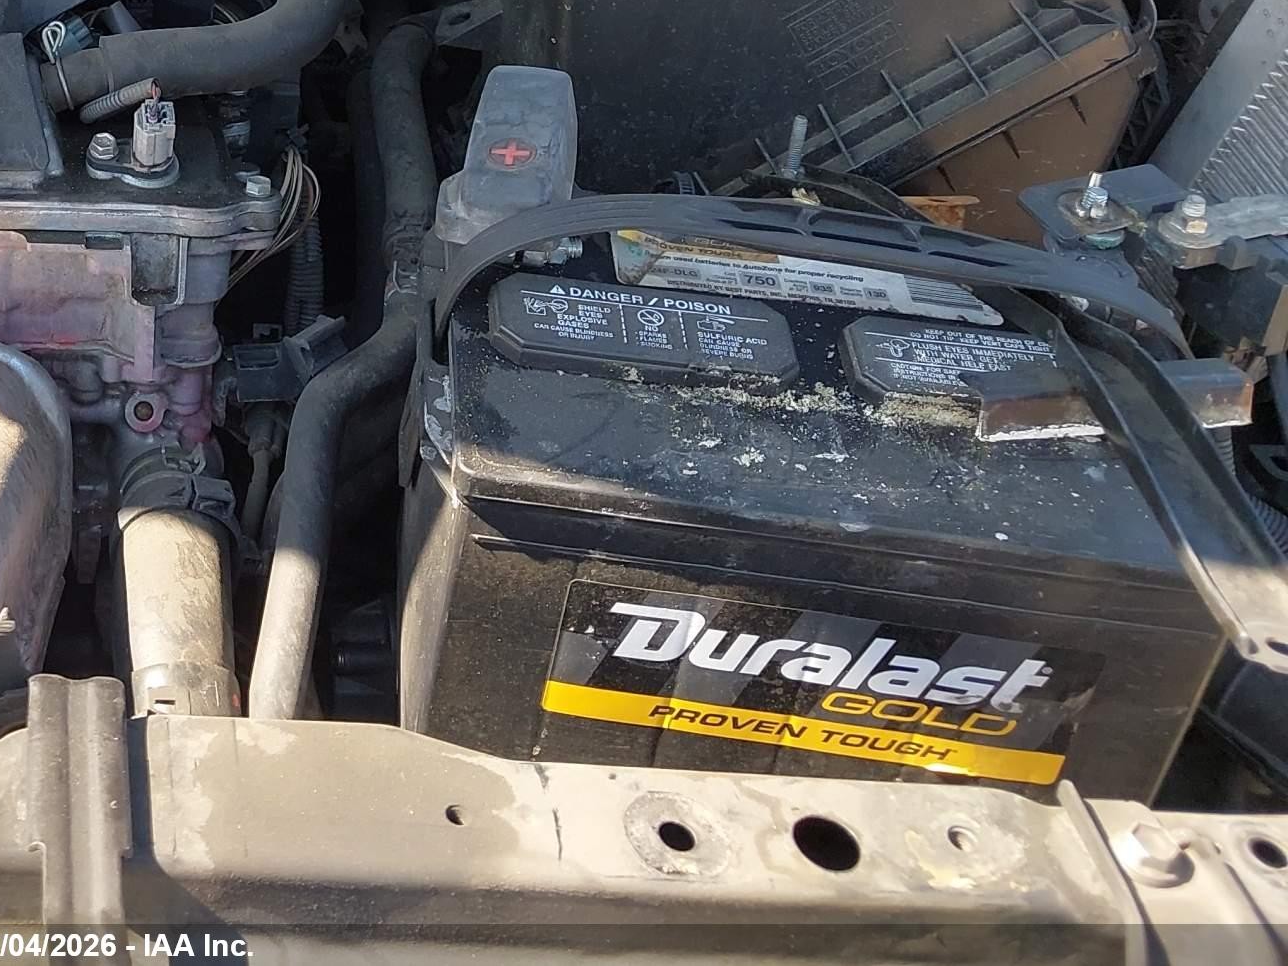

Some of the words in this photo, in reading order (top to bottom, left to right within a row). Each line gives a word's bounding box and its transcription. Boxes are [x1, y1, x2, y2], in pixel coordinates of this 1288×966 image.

[695, 257, 730, 267] batteries
[743, 263, 783, 273] AutoZone
[798, 270, 825, 278] proper
[827, 272, 864, 282] recycling
[743, 274, 777, 286] 750
[569, 287, 644, 305] DANGER
[664, 298, 731, 314] POISON
[578, 304, 611, 314] SHIELD
[557, 314, 608, 325] EXPLOSIVE
[557, 320, 590, 328] GASES
[697, 332, 744, 343] SULFURIC
[746, 338, 768, 346] ACID
[912, 342, 943, 352] FLUSH
[945, 345, 968, 354] EYES
[972, 348, 1036, 362] IMMEDIATELY
[913, 348, 939, 358] WITH
[917, 356, 957, 367] MEDICAL
[961, 360, 984, 370] HELP
[610, 601, 1055, 714] Duralast
[819, 692, 1018, 736] GOLD
[647, 705, 808, 739] PROVEN
[820, 729, 952, 761] TOUGH
